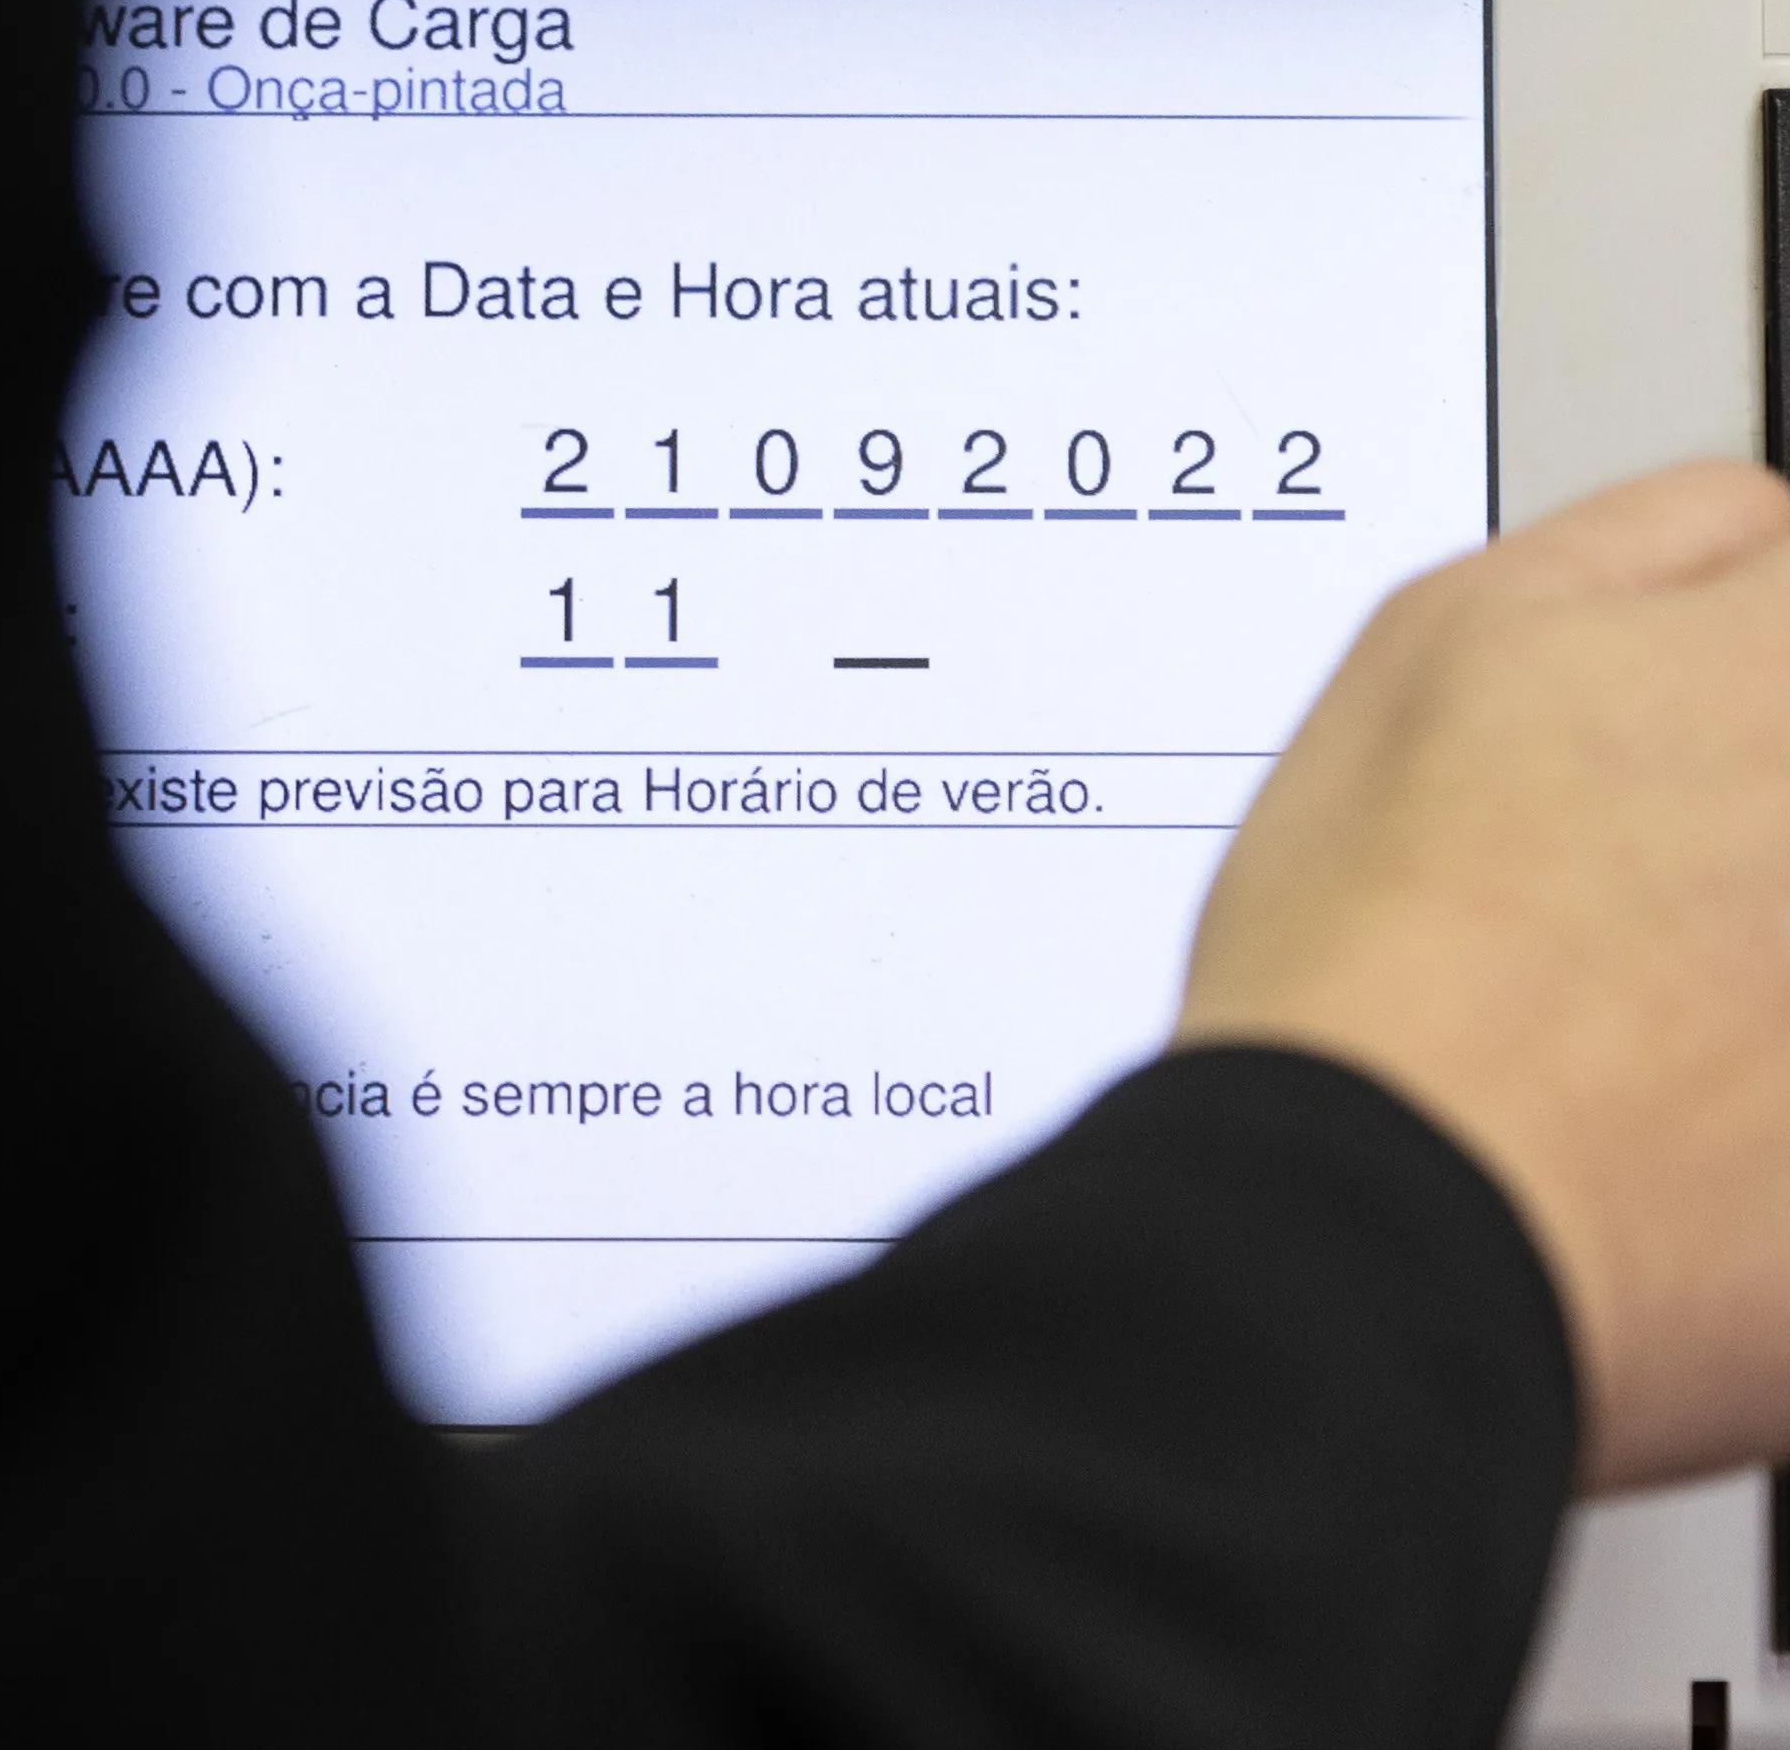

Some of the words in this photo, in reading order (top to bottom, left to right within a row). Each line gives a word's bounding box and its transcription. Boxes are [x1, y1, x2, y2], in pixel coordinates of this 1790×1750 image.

[208, 62, 570, 122] Onça-pintada
[186, 274, 326, 319] com
[357, 276, 394, 319] a
[425, 261, 579, 319] Data
[606, 277, 641, 320] e
[674, 262, 832, 320] Hora
[858, 263, 1079, 321] atuais:
[260, 767, 482, 820] previsão
[505, 778, 622, 820] para
[646, 766, 837, 813] Horário
[858, 768, 921, 813] de
[942, 769, 1102, 814] verão.
[412, 1070, 441, 1117] é
[463, 1082, 661, 1124] sempre
[684, 1082, 713, 1117] a
[736, 1071, 851, 1117] hora
[875, 1071, 991, 1117] local
